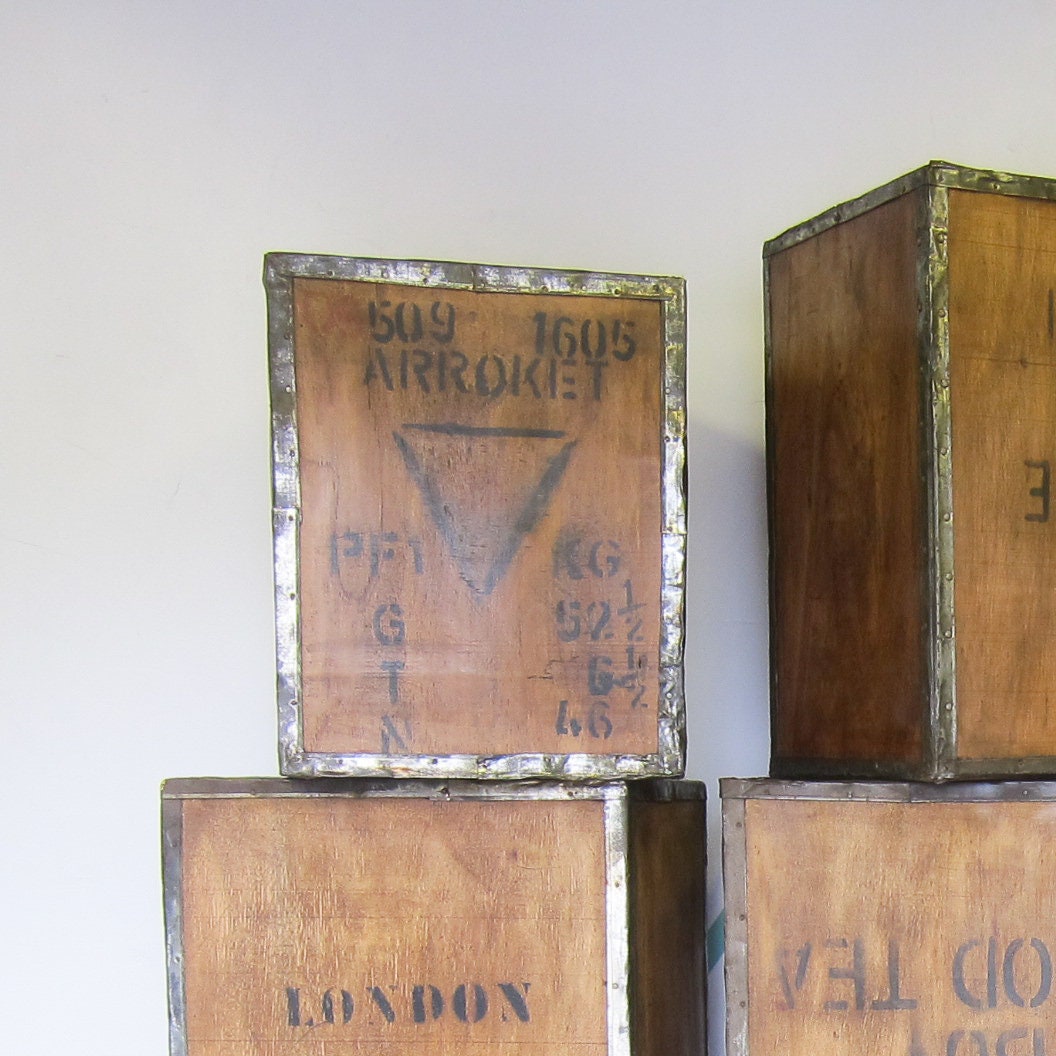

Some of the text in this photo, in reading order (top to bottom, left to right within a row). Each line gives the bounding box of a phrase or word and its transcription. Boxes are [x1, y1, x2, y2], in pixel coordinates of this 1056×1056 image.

[368, 301, 637, 362] 509 1605
[363, 348, 608, 401] ARROKET
[373, 603, 406, 647] G
[380, 660, 405, 704] T
[381, 700, 613, 754] N 46
[775, 938, 918, 1011] TEA
[286, 981, 532, 1027] LONDON
